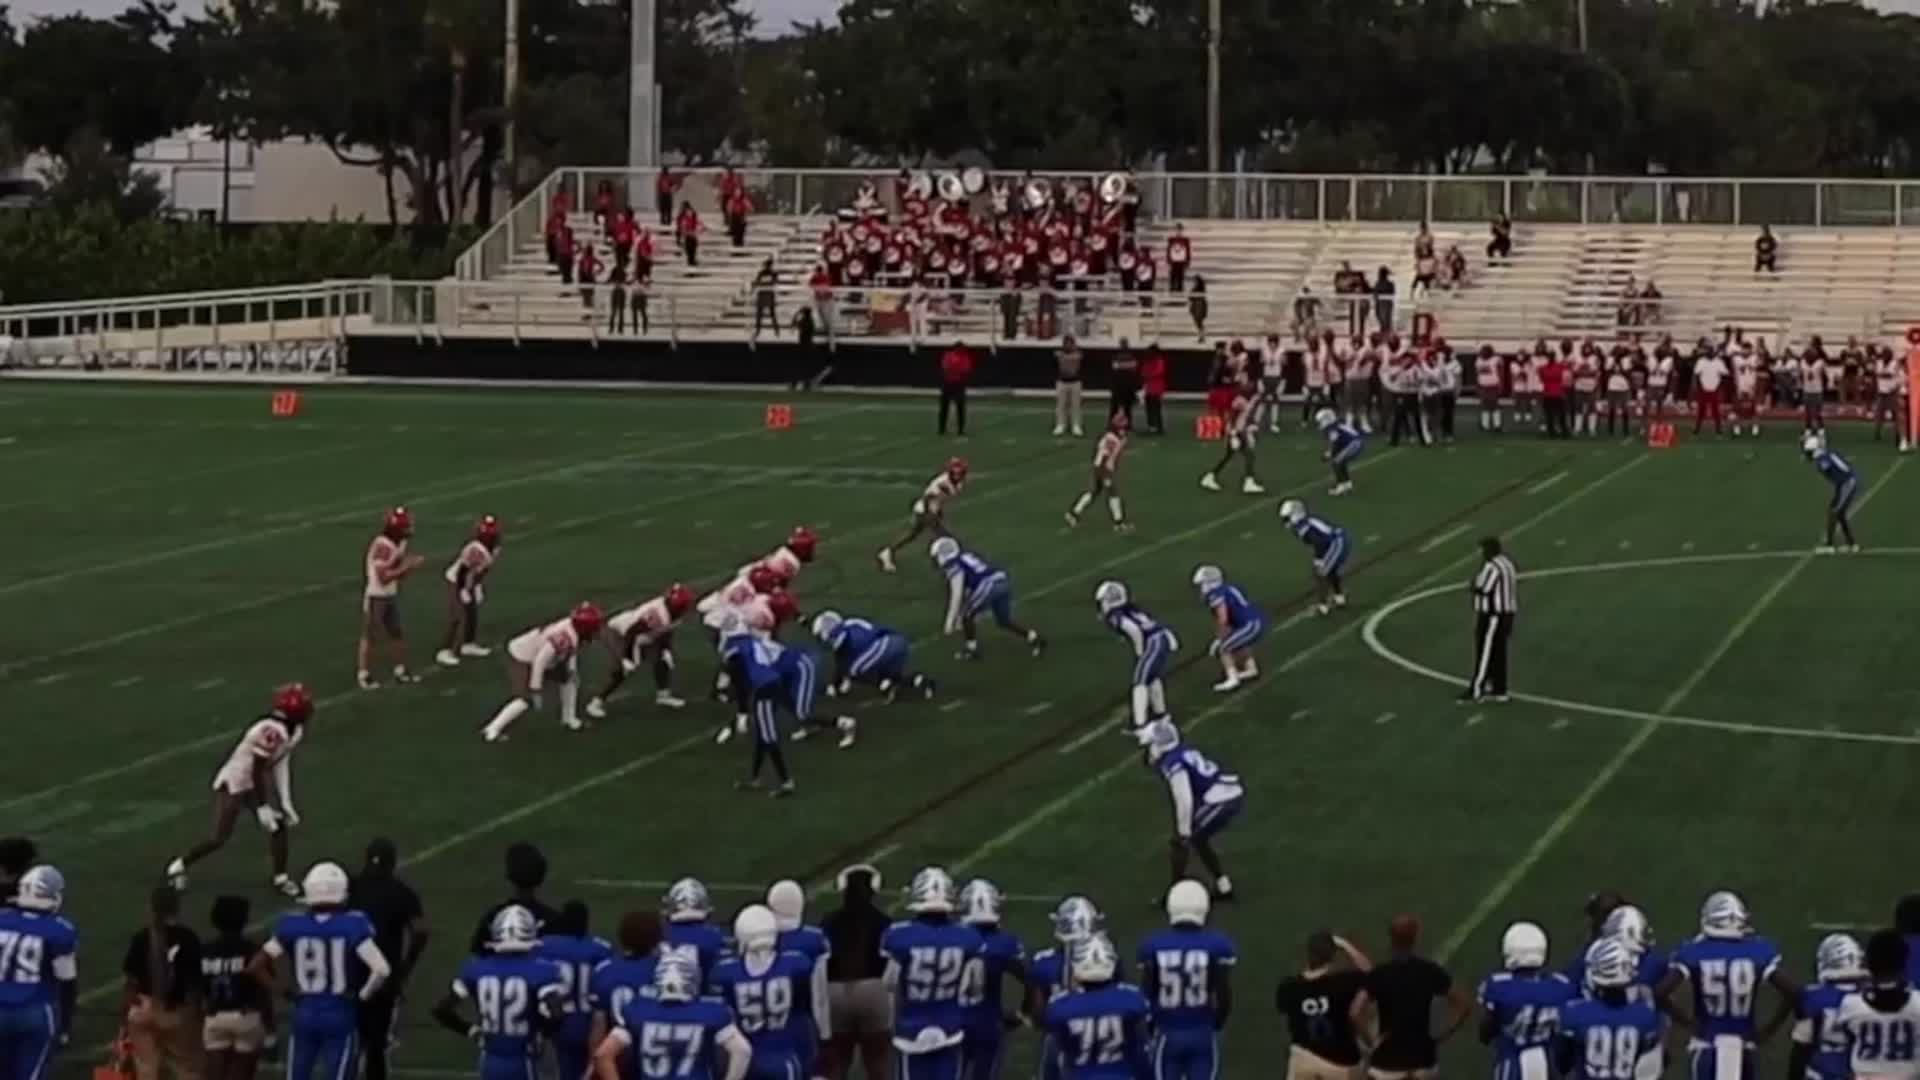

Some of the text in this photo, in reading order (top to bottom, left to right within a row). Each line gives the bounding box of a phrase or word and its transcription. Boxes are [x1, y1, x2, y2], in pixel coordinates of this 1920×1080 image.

[0, 930, 43, 984] 79
[294, 937, 346, 994] 81
[908, 946, 964, 1001] 52
[735, 975, 790, 1032] 59
[639, 1020, 704, 1078] 57
[1066, 1014, 1125, 1065] 72
